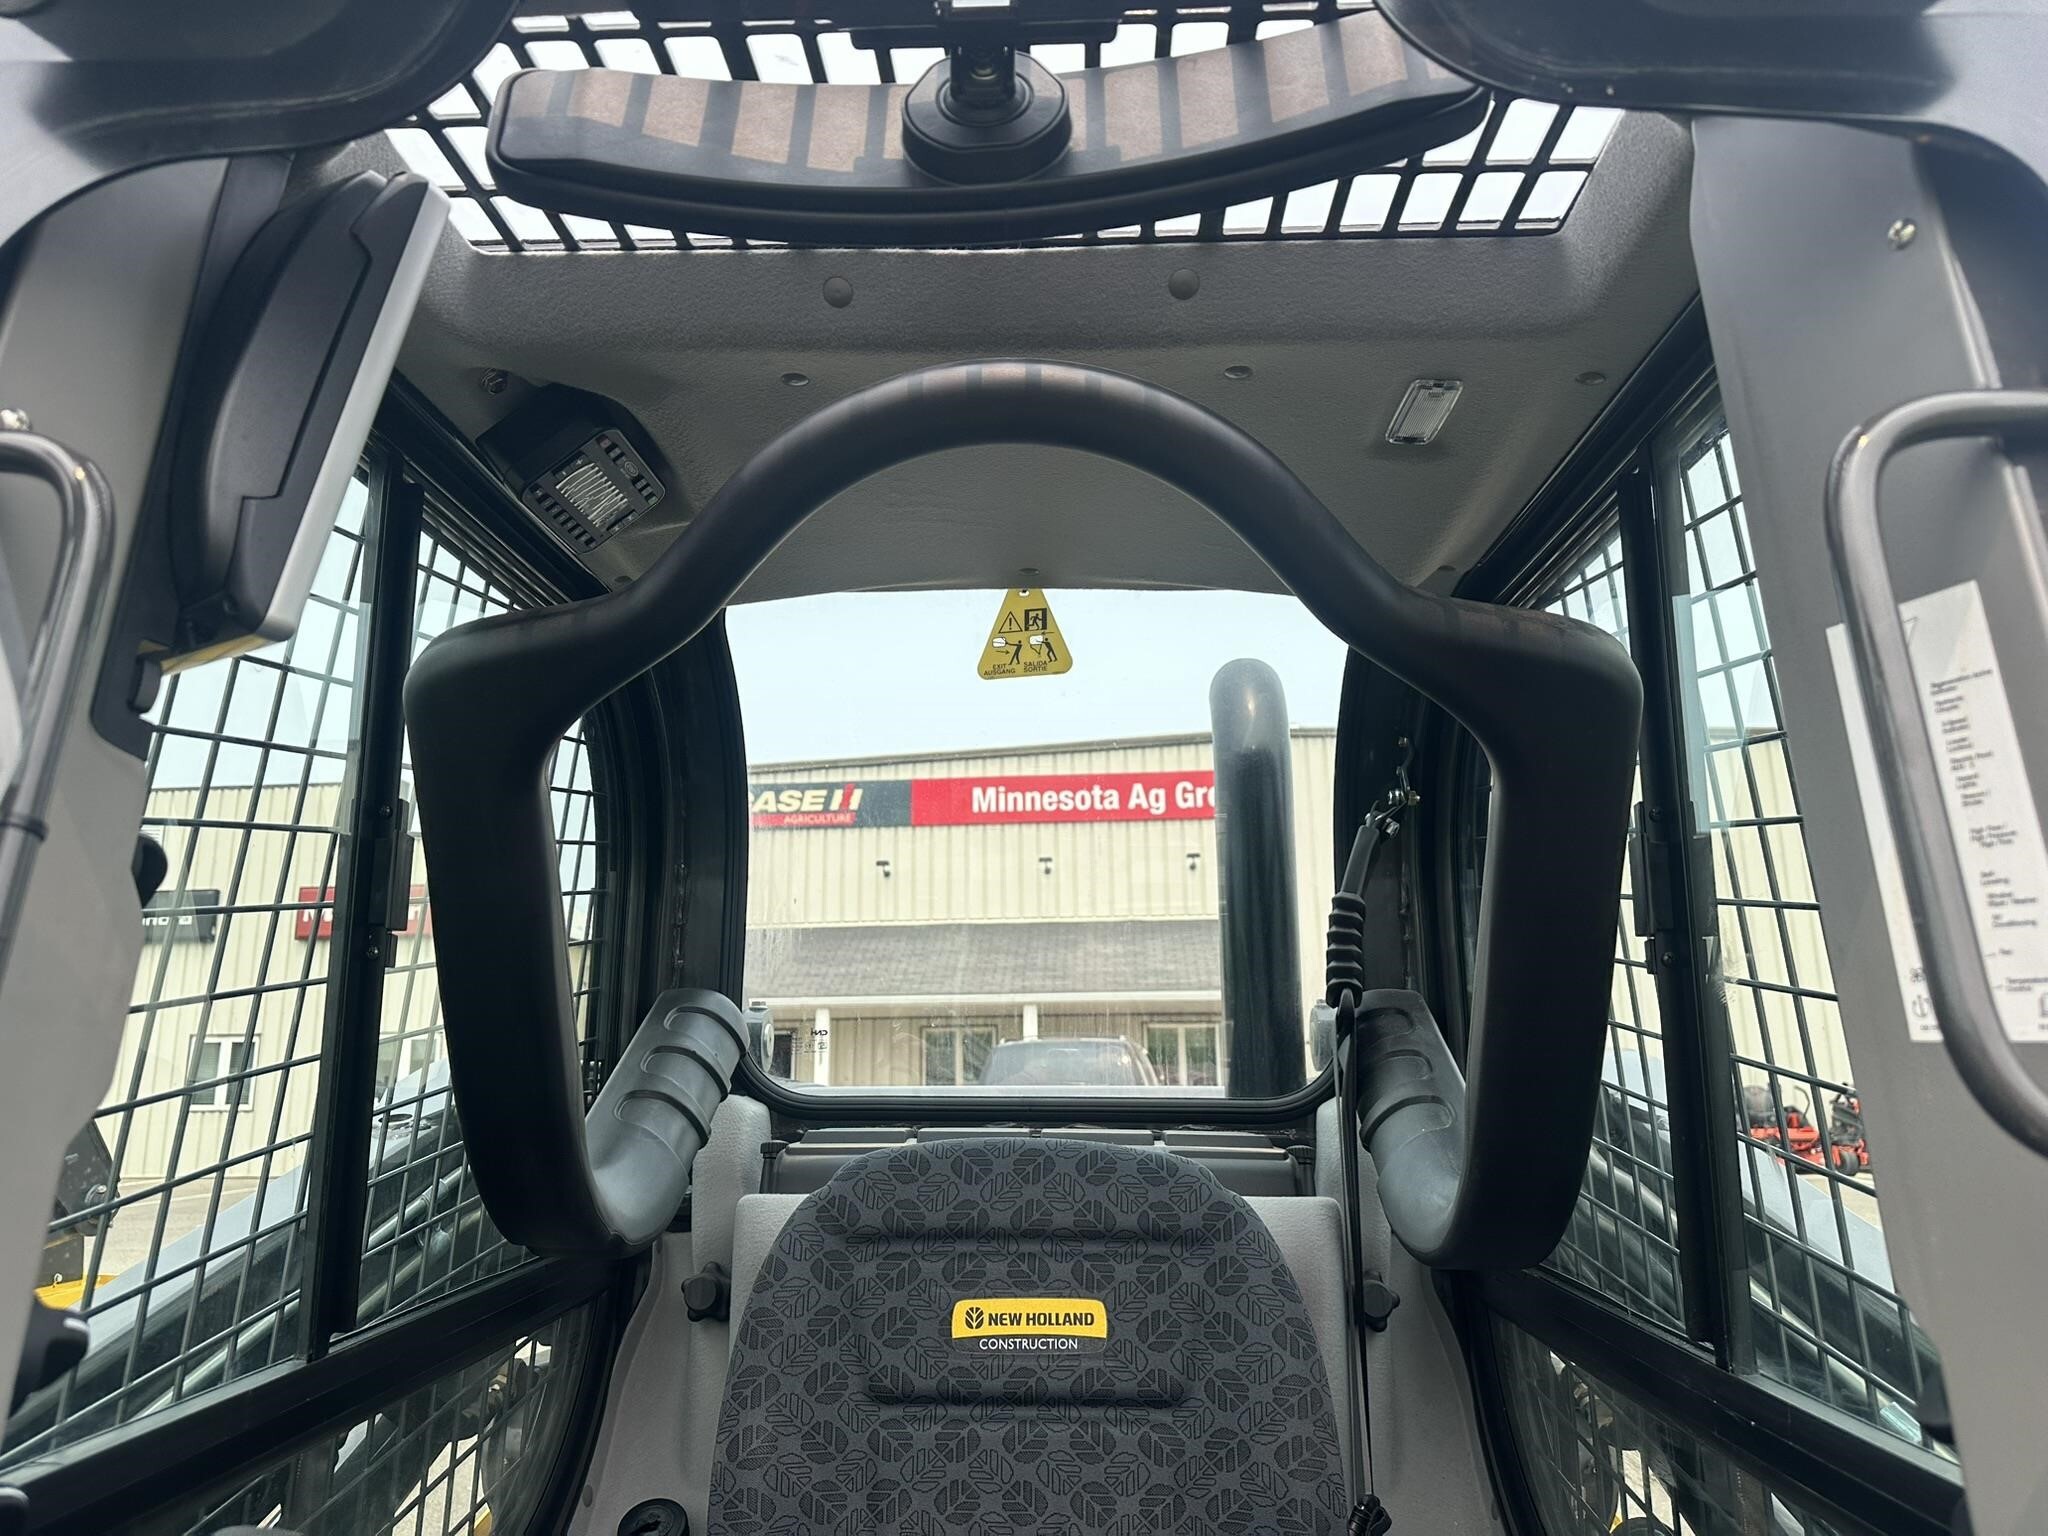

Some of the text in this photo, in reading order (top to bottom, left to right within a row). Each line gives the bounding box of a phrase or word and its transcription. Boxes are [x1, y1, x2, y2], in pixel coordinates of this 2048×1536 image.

[983, 668, 1016, 676] AUSGANG
[972, 785, 1120, 815] Minnesota
[1127, 782, 1167, 815] Ag
[783, 813, 852, 824] AGRICULTURE
[988, 1312, 1095, 1326] NEW HOLLAND
[978, 1338, 1079, 1350] CONSTRUCTION
